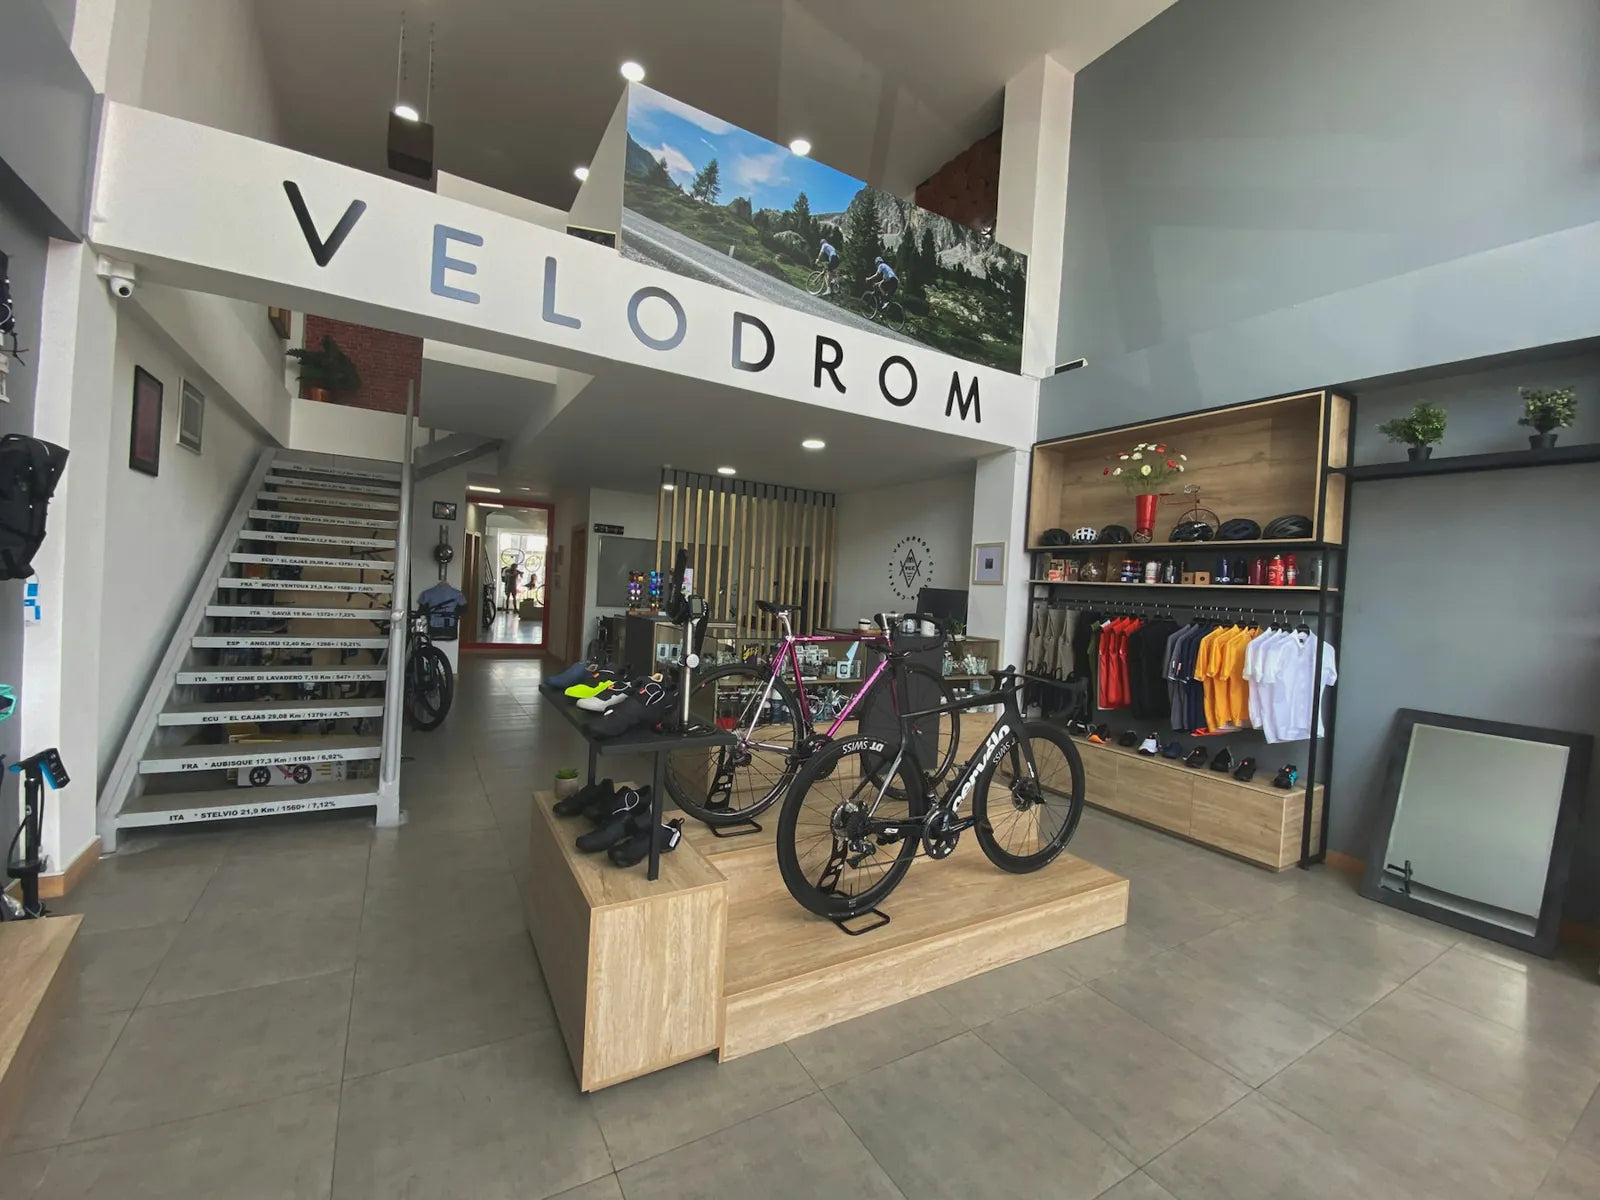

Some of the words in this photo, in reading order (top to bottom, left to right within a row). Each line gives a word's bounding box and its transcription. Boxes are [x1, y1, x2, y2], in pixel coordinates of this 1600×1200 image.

[283, 180, 981, 423] VELODROM
[842, 740, 869, 754] SWISS
[869, 741, 884, 753] DT
[992, 741, 1011, 765] SWISS
[211, 759, 253, 769] AUBISQUE
[256, 758, 272, 766] 17,3
[169, 814, 184, 822] ITA
[201, 809, 238, 819] STELVIO
[240, 808, 259, 816] 21,9
[261, 806, 275, 814] Km
[282, 804, 306, 812] 1560+
[312, 801, 336, 809] 7,12%
